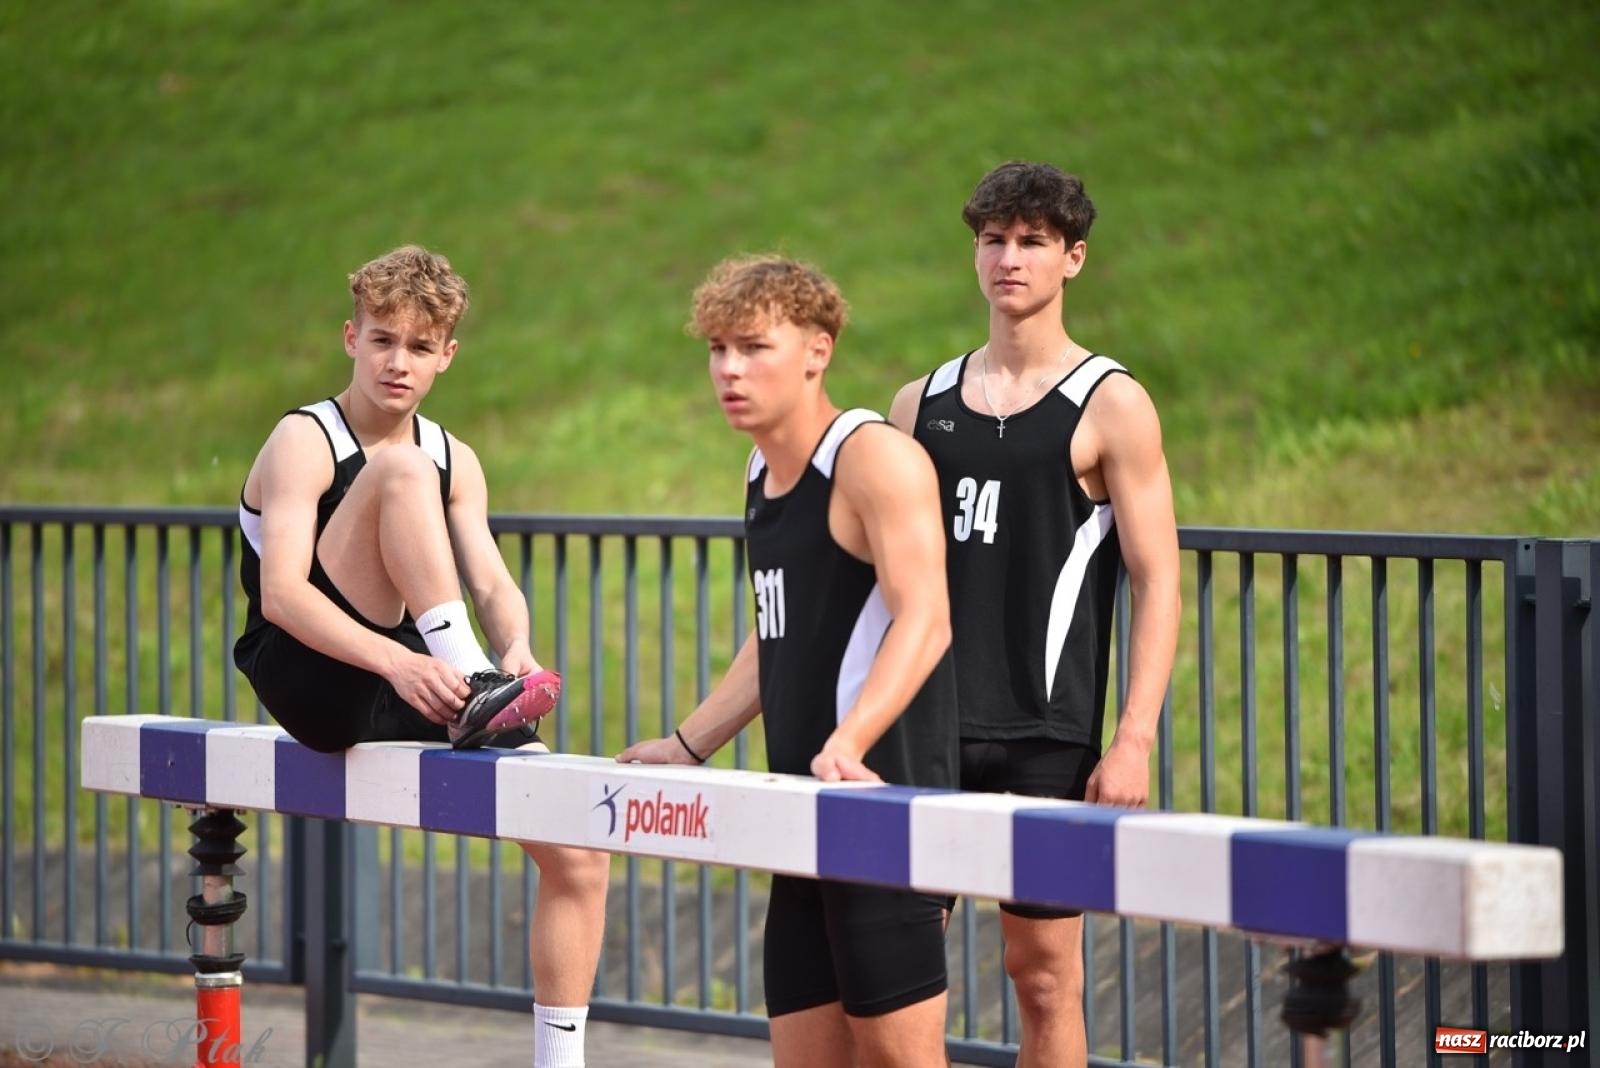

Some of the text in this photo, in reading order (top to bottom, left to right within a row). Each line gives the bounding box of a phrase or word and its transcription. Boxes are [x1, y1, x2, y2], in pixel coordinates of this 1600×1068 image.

[953, 476, 1001, 544] 34
[754, 567, 785, 640] 311
[625, 789, 709, 842] polanik
